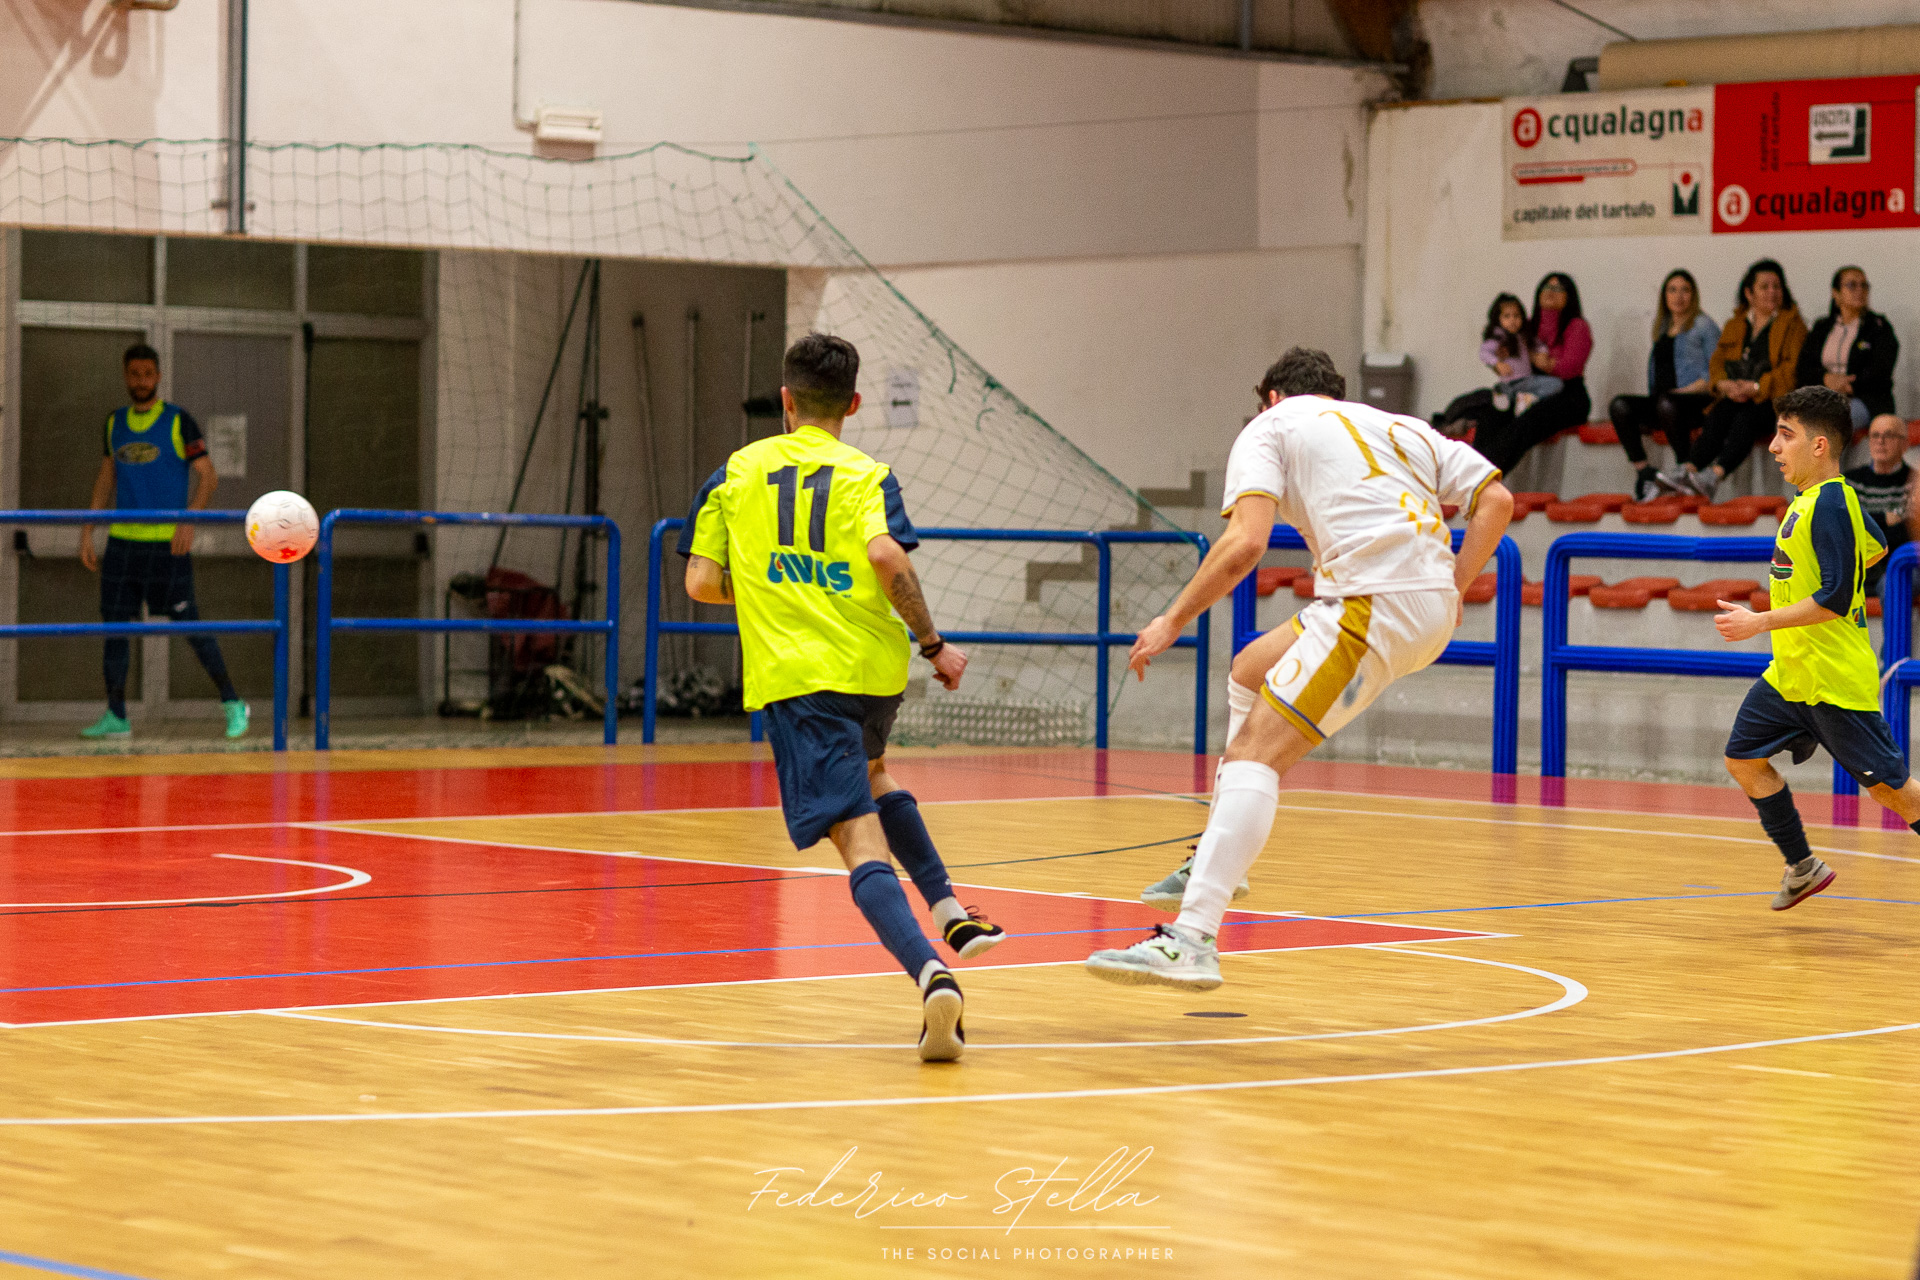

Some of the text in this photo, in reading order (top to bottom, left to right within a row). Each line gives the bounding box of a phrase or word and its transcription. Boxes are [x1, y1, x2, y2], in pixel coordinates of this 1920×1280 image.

[1513, 200, 1656, 223] capitale del tartufo
[767, 465, 835, 552] 11
[767, 552, 853, 591] AVIS
